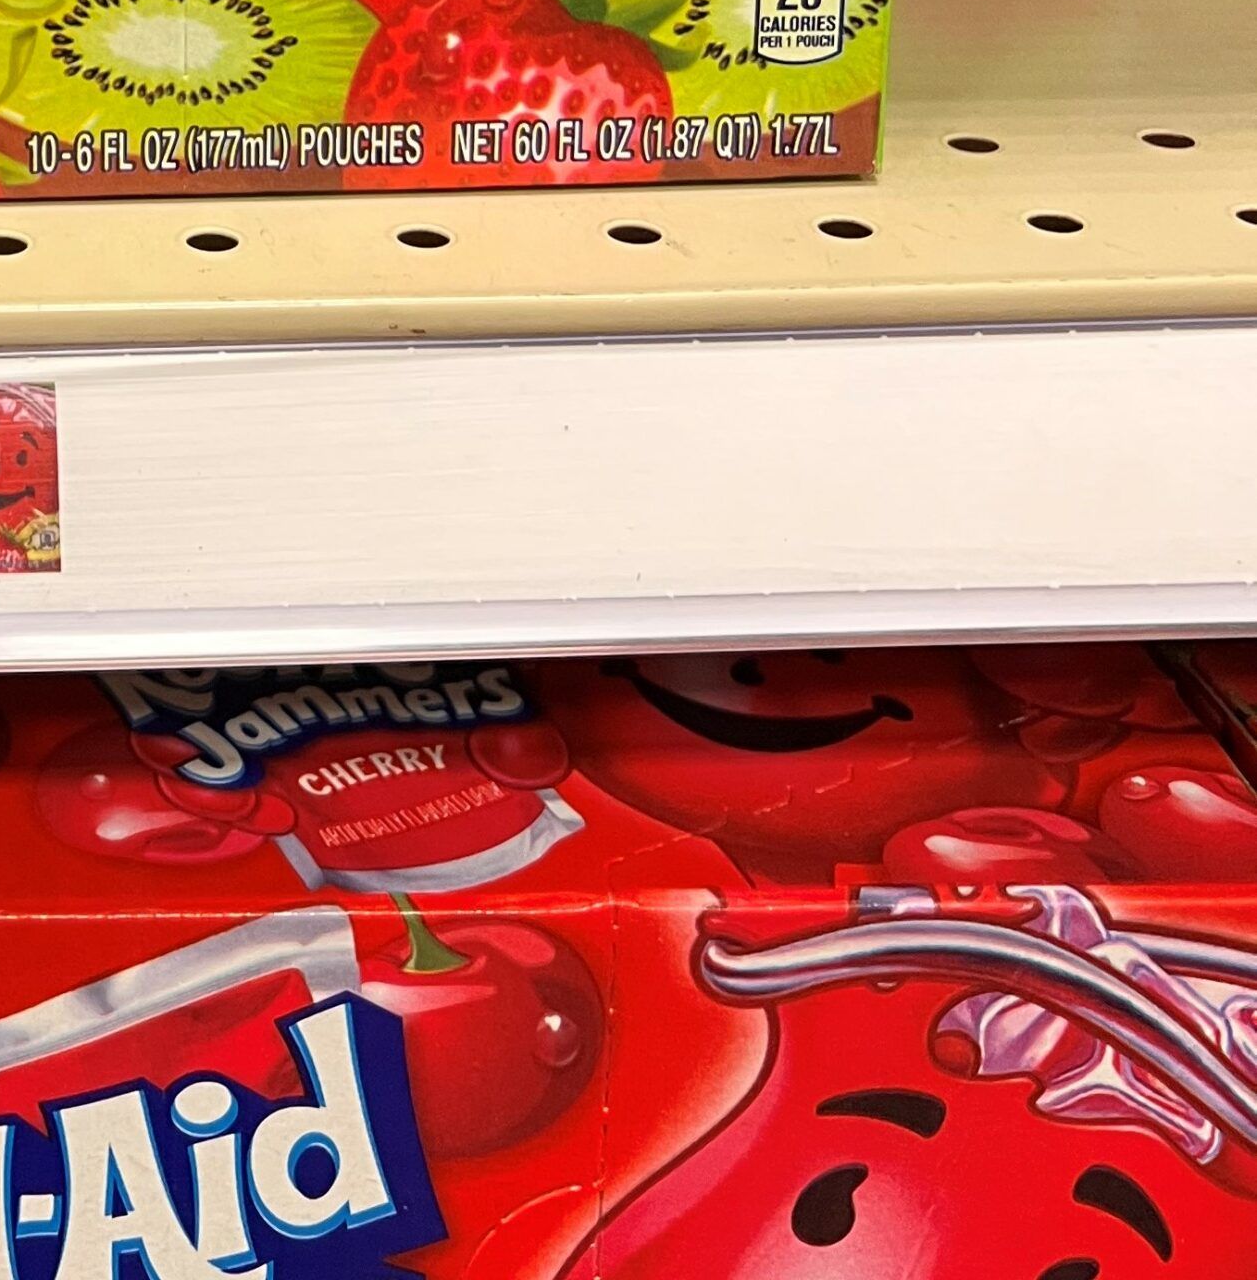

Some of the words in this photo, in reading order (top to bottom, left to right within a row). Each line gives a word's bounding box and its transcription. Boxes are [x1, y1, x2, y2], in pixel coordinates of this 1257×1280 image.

[760, 15, 836, 32] CALORIES
[761, 36, 782, 48] PER
[787, 36, 792, 47] 1
[796, 35, 834, 47] POUCH
[27, 133, 94, 173] 10-6
[103, 132, 133, 171] FL
[143, 130, 179, 170] OZ
[185, 126, 289, 172] (177mL)
[299, 124, 423, 166] POUCHES
[452, 122, 505, 162] NET
[514, 121, 546, 162] 60
[558, 120, 589, 161] FL
[599, 119, 633, 160] OZ
[643, 118, 706, 162] (1.87
[714, 116, 760, 159] QT)
[770, 115, 838, 155] 1.77L
[174, 668, 524, 785] Jammers
[298, 745, 446, 796] CHERRY
